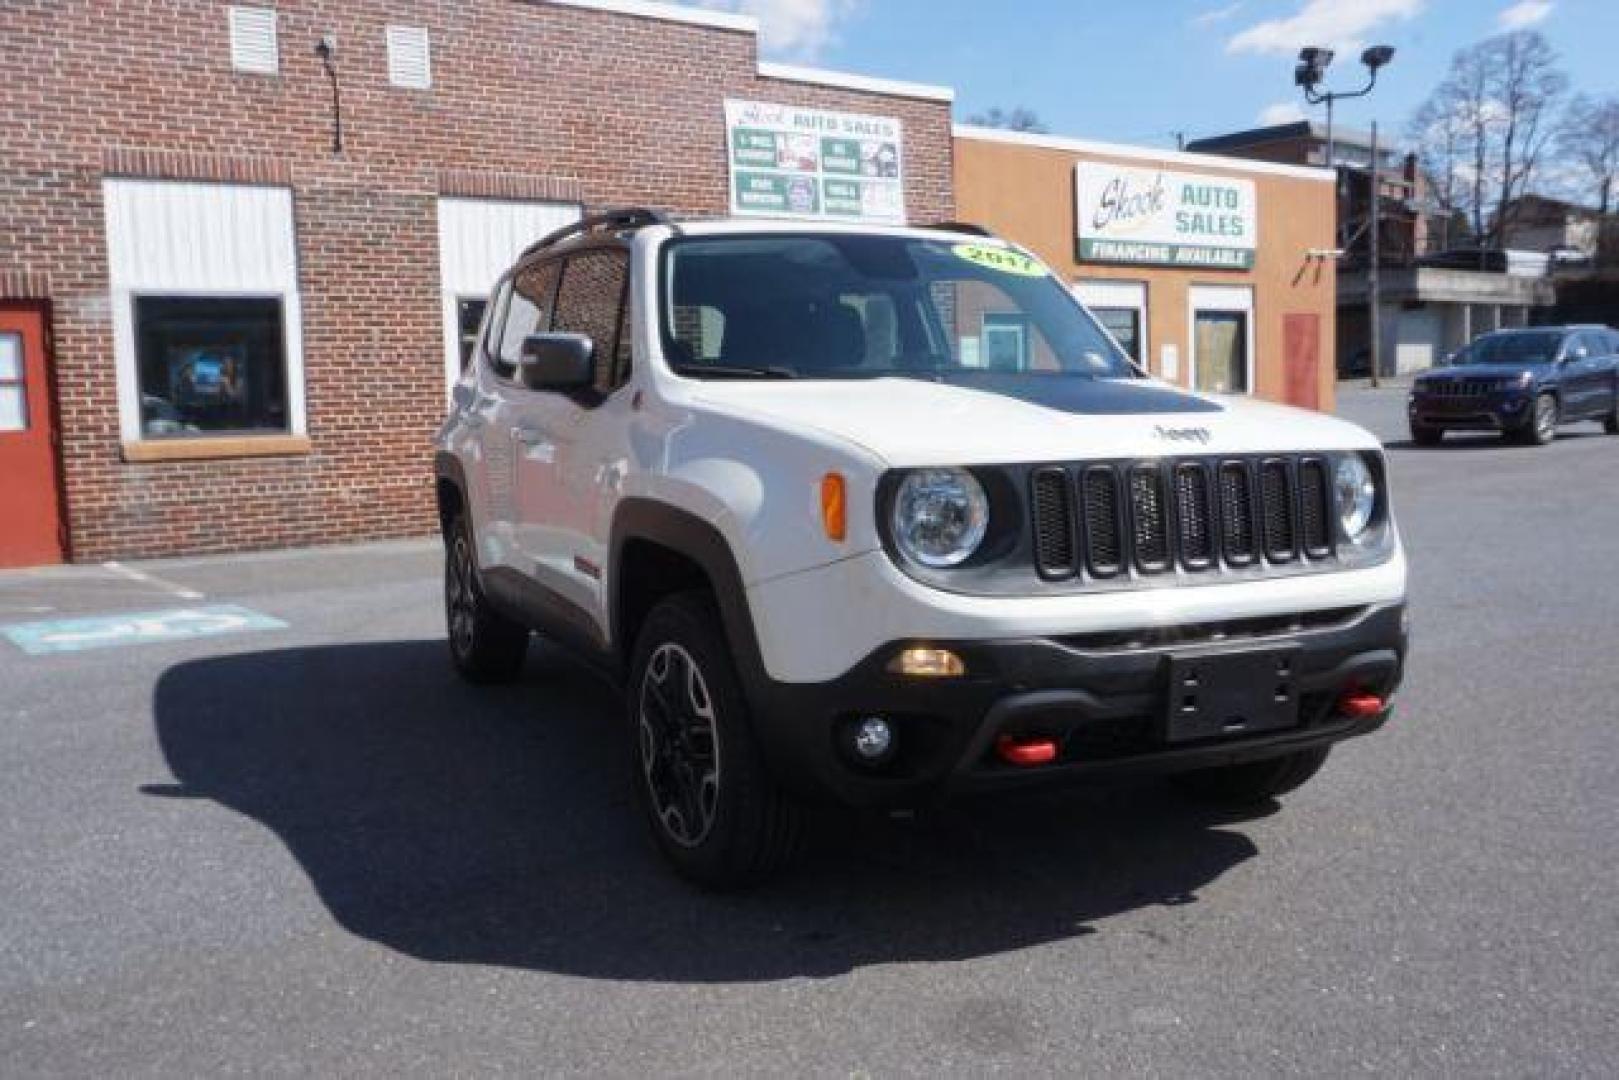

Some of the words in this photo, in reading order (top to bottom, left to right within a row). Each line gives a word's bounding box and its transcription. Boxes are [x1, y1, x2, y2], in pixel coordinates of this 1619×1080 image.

[793, 113, 838, 130] AUTO
[1181, 184, 1238, 209] AUTO
[1175, 211, 1244, 236] SALES
